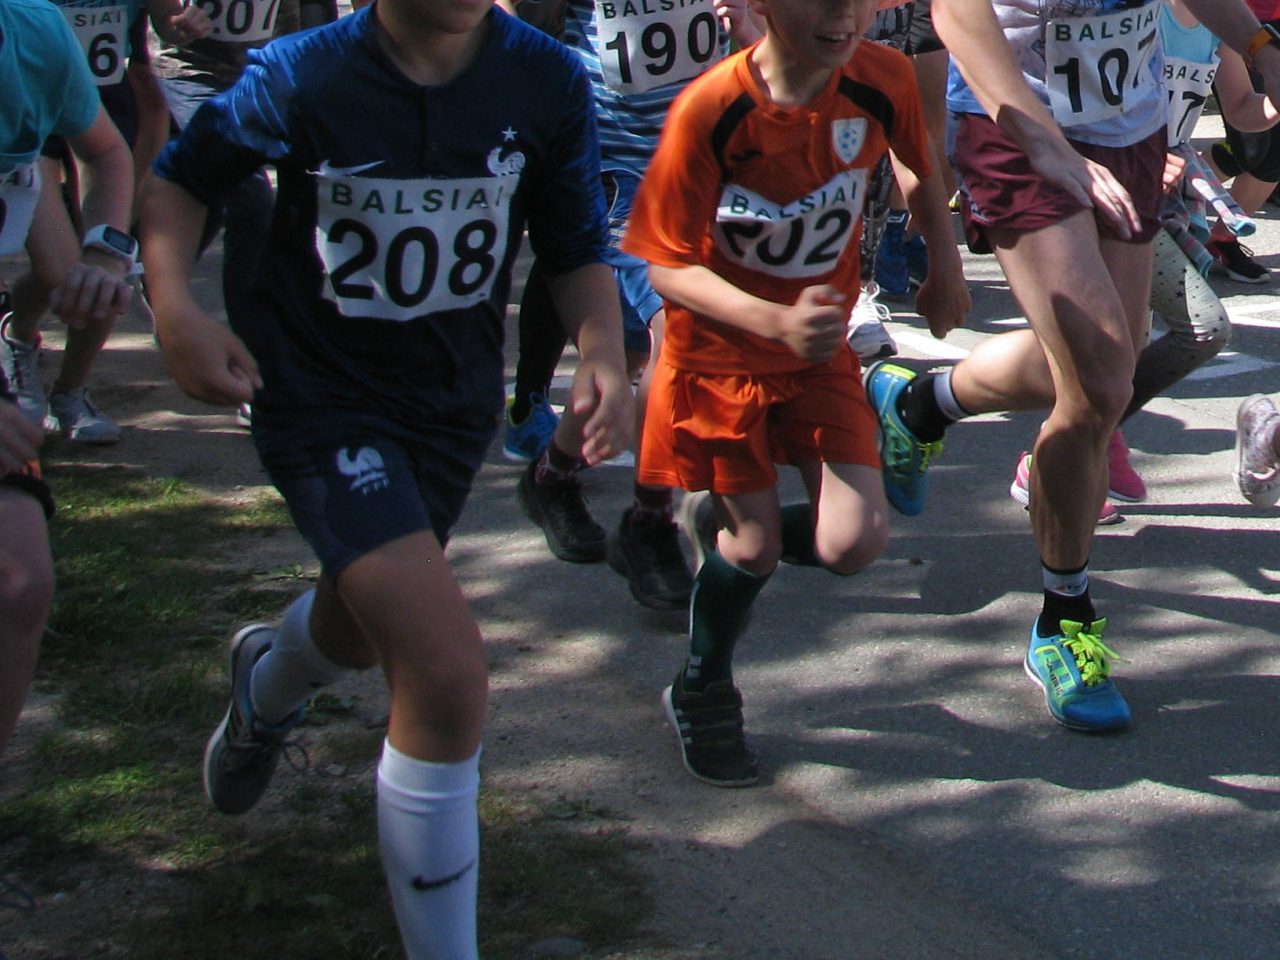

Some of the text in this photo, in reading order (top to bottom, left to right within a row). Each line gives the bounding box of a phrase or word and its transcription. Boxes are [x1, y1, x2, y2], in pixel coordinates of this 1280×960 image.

[74, 11, 121, 27] SIAI
[606, 11, 717, 84] 190
[1164, 63, 1215, 84] BALS
[331, 183, 504, 215] BALSIAI
[327, 218, 498, 308] 208
